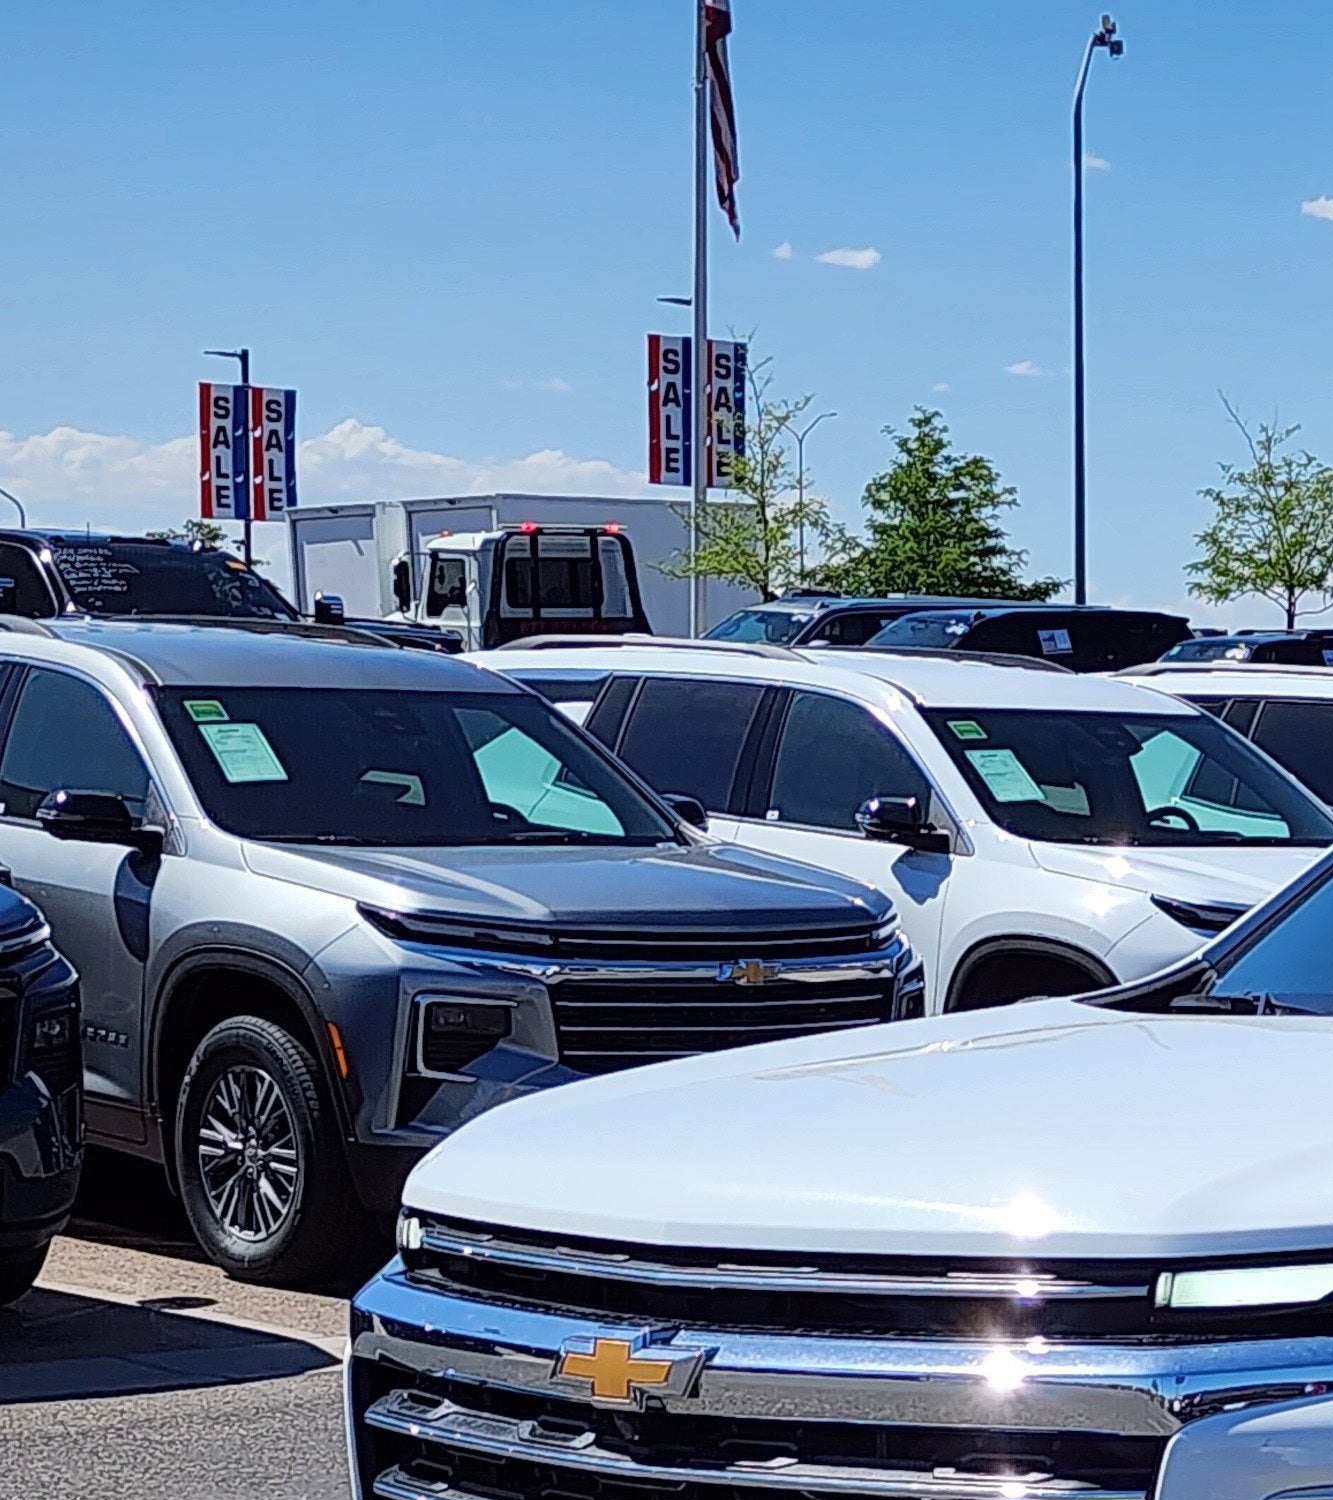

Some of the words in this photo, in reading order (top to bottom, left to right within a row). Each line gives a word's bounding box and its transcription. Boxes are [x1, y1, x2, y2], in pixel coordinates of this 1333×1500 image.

[212, 396, 231, 509] SALE
[265, 399, 284, 511] SALE
[662, 349, 681, 473] SALE
[714, 354, 732, 477] SALE
